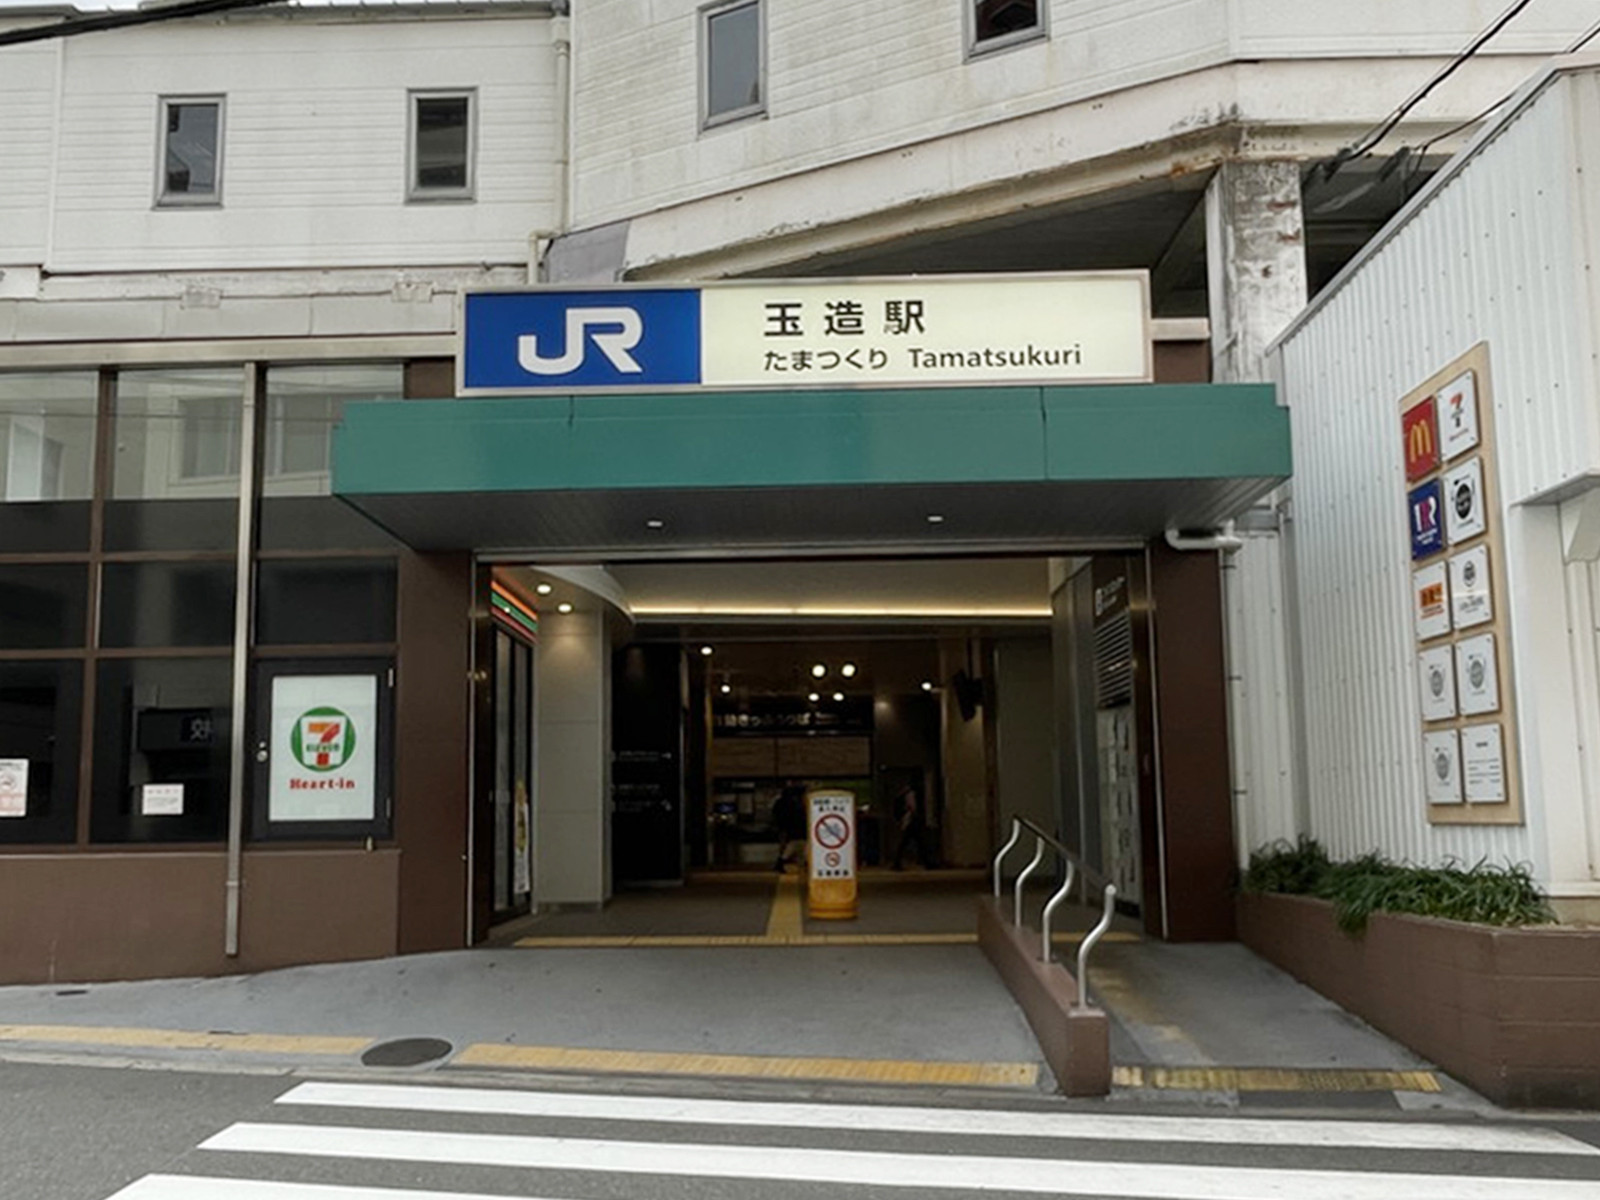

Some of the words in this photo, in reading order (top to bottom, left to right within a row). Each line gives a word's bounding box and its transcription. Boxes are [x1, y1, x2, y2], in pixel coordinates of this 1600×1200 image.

[763, 299, 926, 337] 玉造駅
[518, 306, 643, 375] JR
[764, 348, 889, 371] たまつくり
[907, 344, 1082, 368] Tamatsukuri
[289, 777, 356, 790] Heart-in
